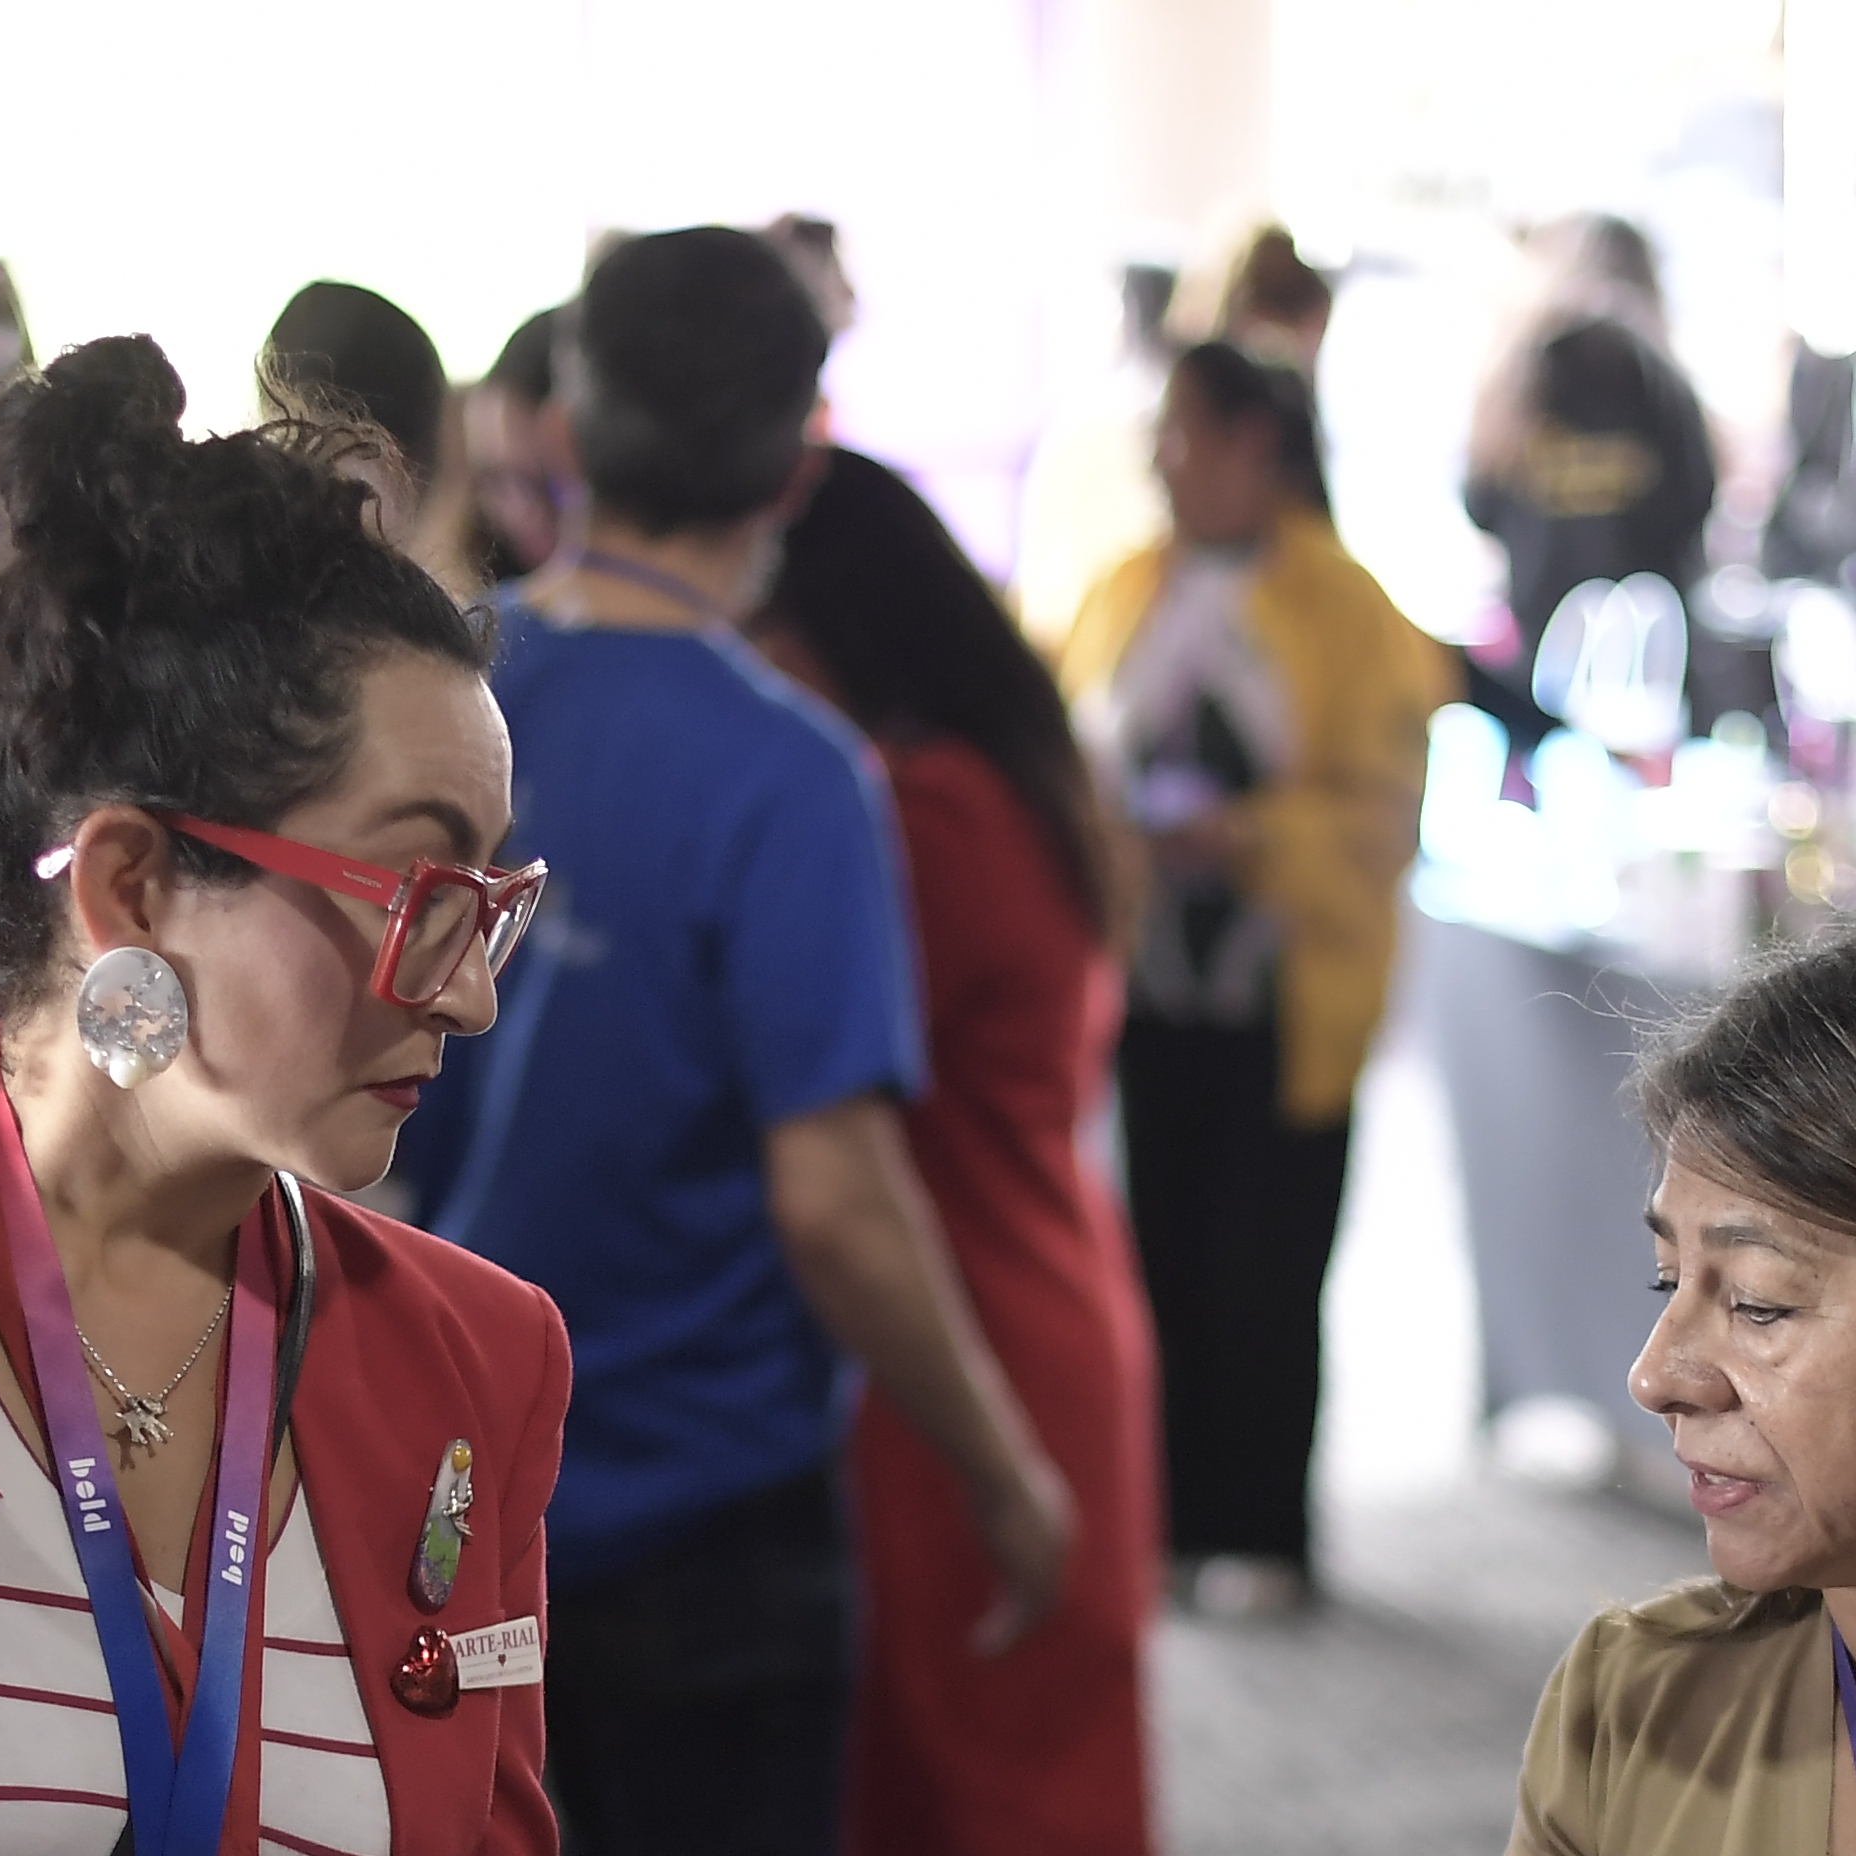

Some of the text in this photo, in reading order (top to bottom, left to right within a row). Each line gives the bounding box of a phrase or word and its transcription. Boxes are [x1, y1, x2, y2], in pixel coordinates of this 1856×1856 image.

[68, 1457, 112, 1533] bold
[221, 1509, 250, 1586] bold
[455, 1626, 537, 1657] ARTE-RIAL
